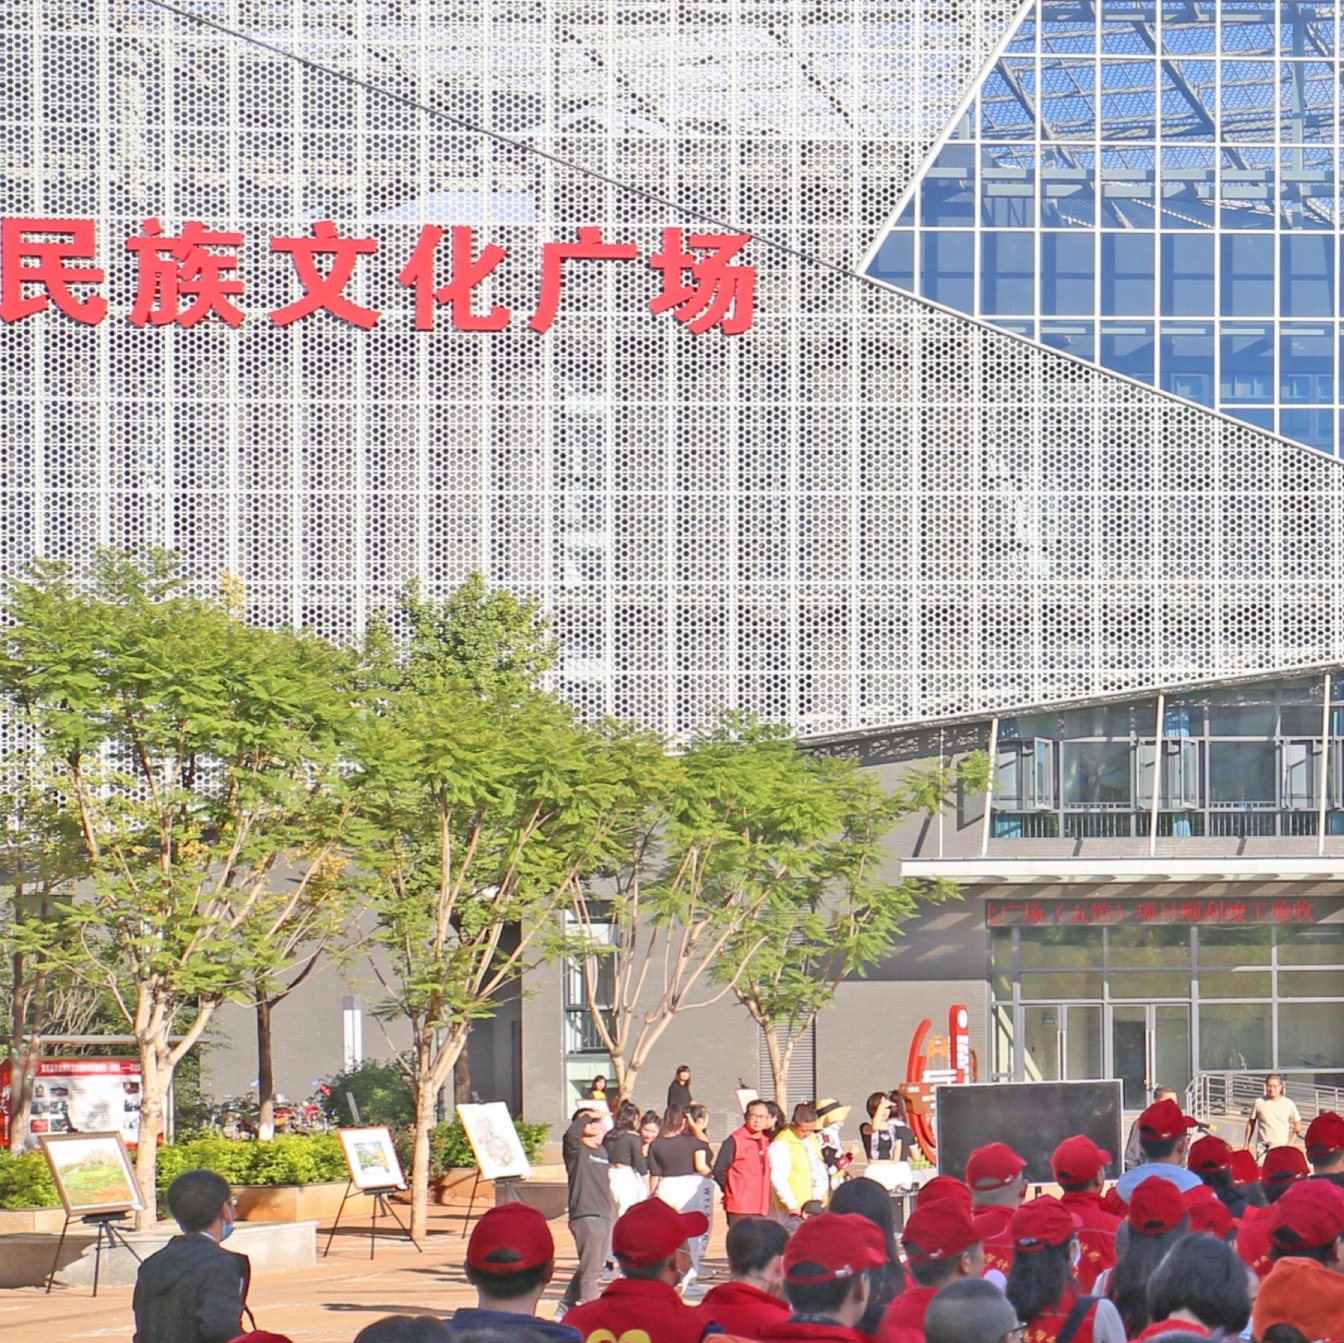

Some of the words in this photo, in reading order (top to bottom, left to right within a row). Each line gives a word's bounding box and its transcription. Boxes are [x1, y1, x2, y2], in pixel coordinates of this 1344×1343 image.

[1, 217, 758, 336] 民族文化广场
